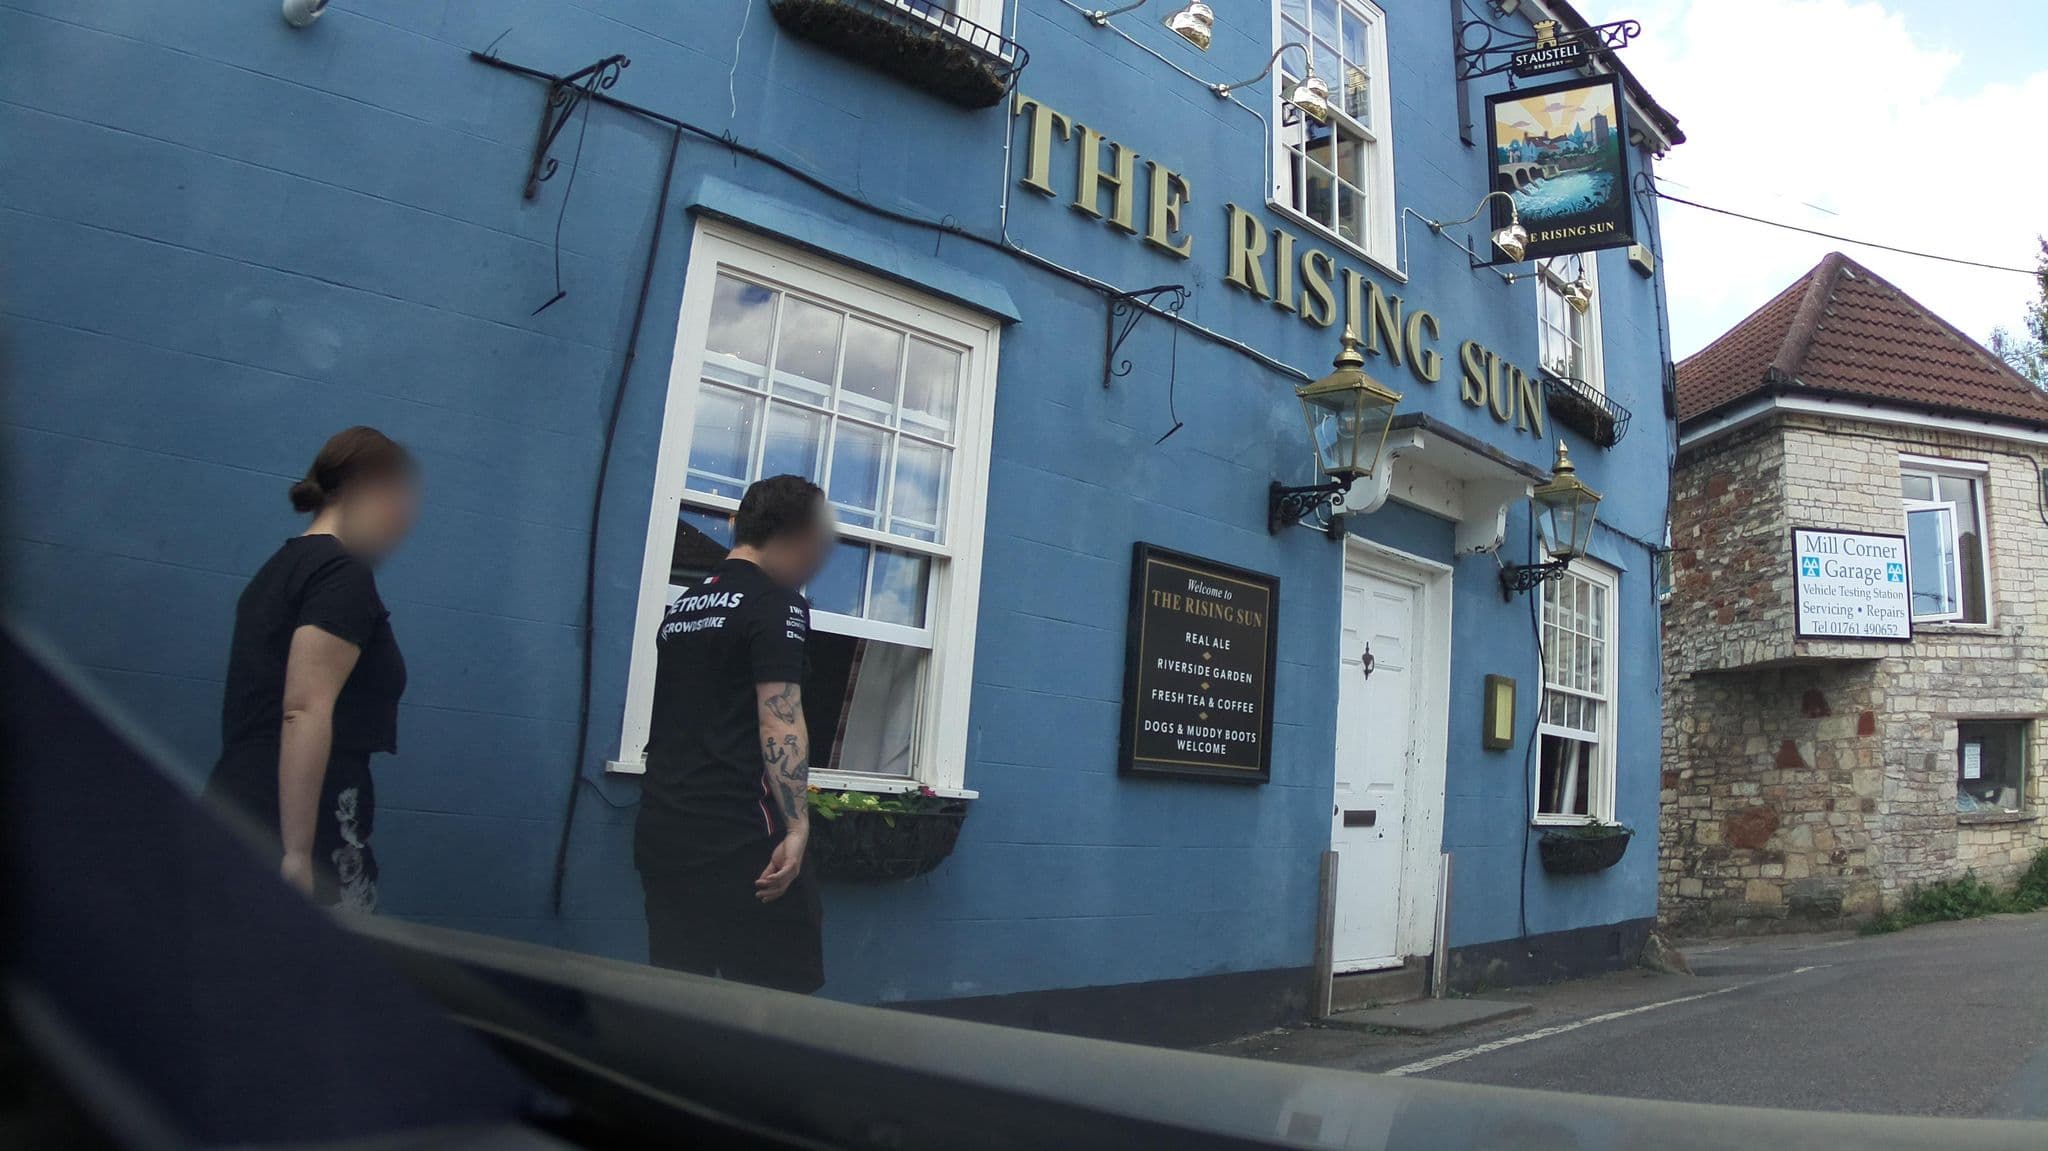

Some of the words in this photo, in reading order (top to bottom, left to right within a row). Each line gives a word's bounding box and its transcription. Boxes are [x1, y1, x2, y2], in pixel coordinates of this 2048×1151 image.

[1528, 45, 1580, 64] AUSTELL
[1534, 60, 1564, 70] BREWERY
[1541, 226, 1587, 241] RISING
[1589, 221, 1615, 234] SUN
[1016, 93, 1193, 260] THE
[1222, 201, 1442, 384] RISING
[1460, 338, 1545, 440] SUN
[1804, 535, 1838, 554] Mill
[1843, 538, 1897, 558] Corner
[1824, 559, 1882, 586] Garage
[1188, 578, 1222, 598] Welcome
[1223, 590, 1232, 600] to
[1803, 583, 1837, 596] Vehicle
[1839, 585, 1872, 601] Testing
[1873, 588, 1904, 600] Station
[1152, 589, 1181, 611] THE
[1185, 597, 1233, 622] RISING
[1236, 608, 1263, 628] SUN
[1803, 601, 1854, 619] Servicing
[1866, 604, 1905, 620] Repairs
[1812, 621, 1828, 633] Tel
[1830, 622, 1860, 634] 01761
[1185, 632, 1210, 646] REAL
[1212, 638, 1230, 650] ALE
[1157, 658, 1210, 677] RIVERSIDE
[1213, 668, 1253, 684] GARDEN
[1152, 689, 1184, 704] FRESH
[1187, 694, 1206, 707] TEA
[1208, 697, 1215, 708] &
[1217, 698, 1254, 713] COFFEE
[1144, 720, 1174, 734] DOGS
[1177, 724, 1184, 735] &
[1187, 725, 1223, 739] MUDDY
[1225, 730, 1257, 743] BOOTS
[1177, 739, 1227, 754] WELCOME
